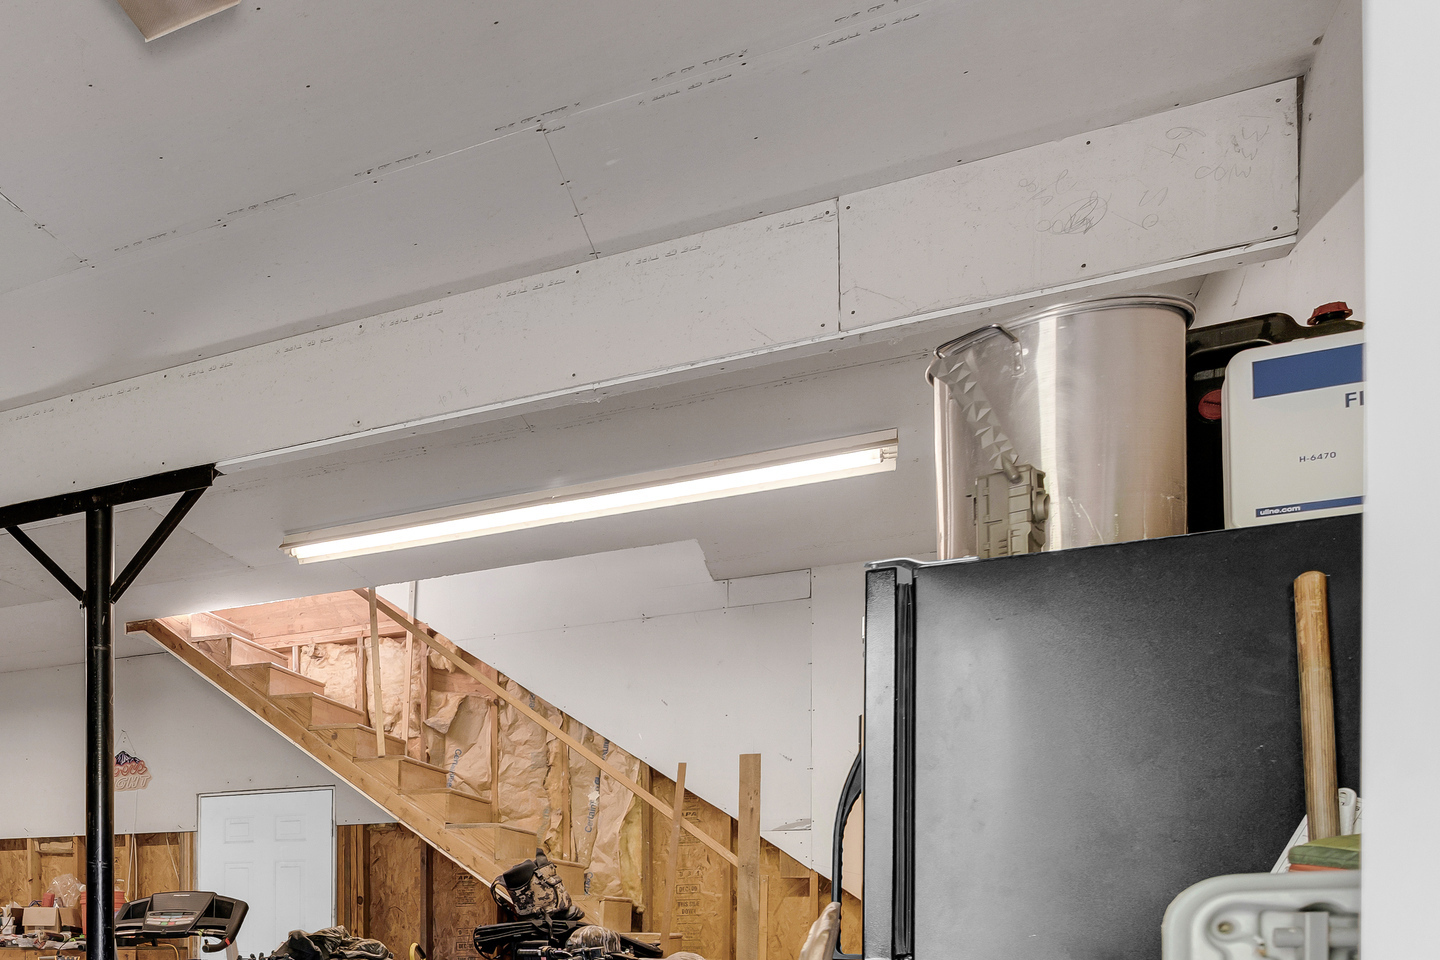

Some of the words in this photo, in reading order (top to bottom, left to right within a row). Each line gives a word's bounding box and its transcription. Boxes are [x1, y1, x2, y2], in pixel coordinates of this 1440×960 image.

[1344, 390, 1364, 408] FI
[1299, 451, 1337, 463] H-6470
[1259, 504, 1301, 516] uline.com
[115, 775, 152, 790] GHT
